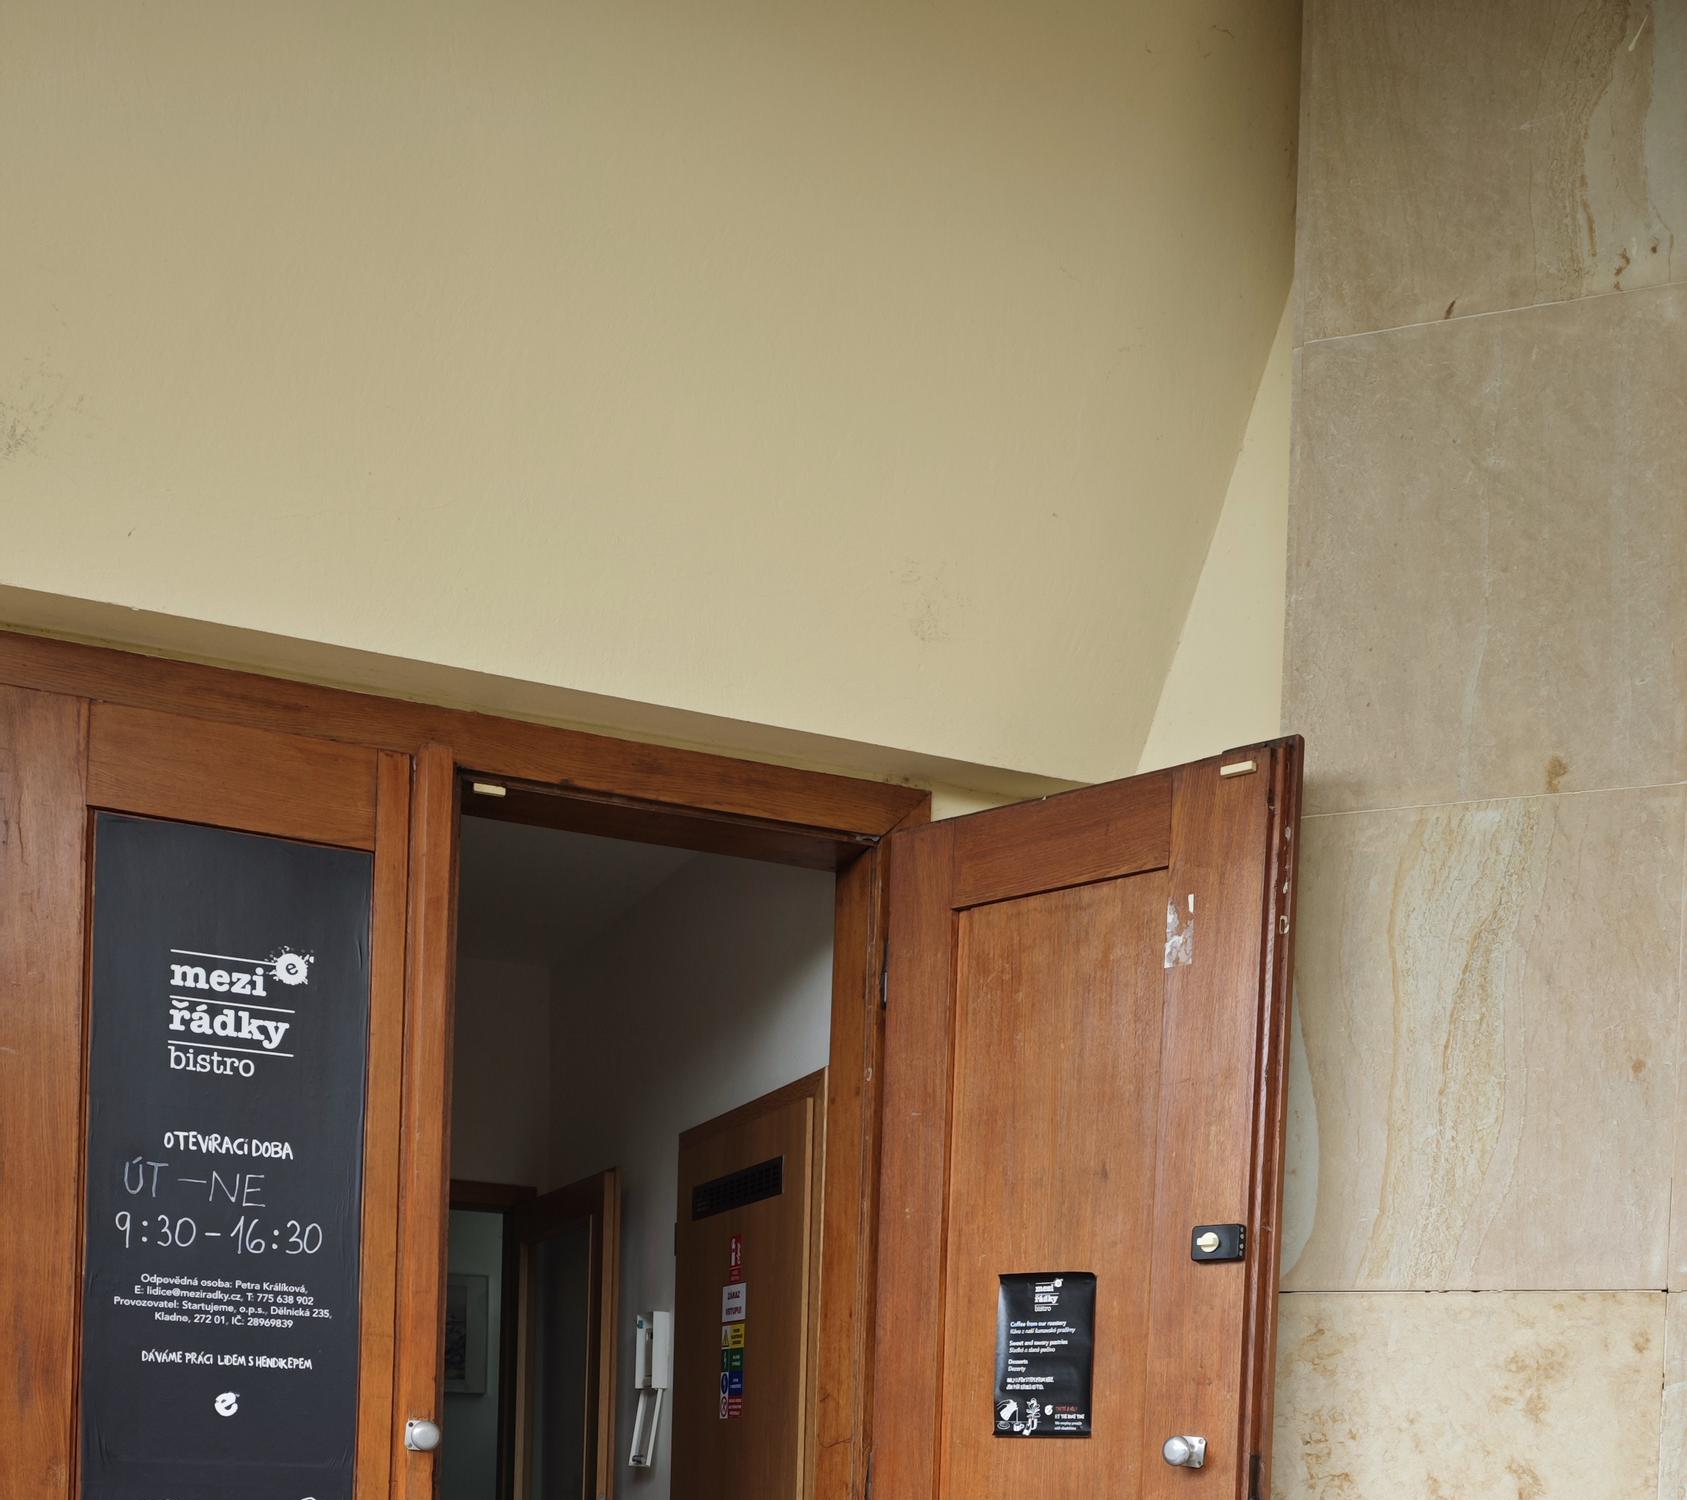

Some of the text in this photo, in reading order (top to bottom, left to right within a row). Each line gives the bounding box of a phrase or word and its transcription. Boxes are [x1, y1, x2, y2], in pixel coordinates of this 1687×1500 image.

[170, 963, 267, 996] mezi
[168, 999, 289, 1049] řádky
[168, 1046, 255, 1077] bistro
[251, 1139, 293, 1160] DOBA
[123, 1156, 168, 1197] ÚT
[208, 1170, 266, 1207] NE
[140, 1273, 308, 1294] Odpovědná osoba: Petra Králíková,
[134, 1285, 314, 1306] E: lidice@meziradky.cz, T: 775 638 902
[113, 1296, 180, 1309] Provozovatel:
[182, 1300, 237, 1313] Startujeme,
[270, 1306, 310, 1317] Dělnická
[312, 1308, 332, 1320] 235,
[154, 1312, 191, 1323] Kladno,
[193, 1314, 212, 1325] 272
[231, 1314, 245, 1326] IČ:
[247, 1317, 294, 1329] 28969839
[141, 1349, 313, 1370] DÁVÁME PRÁCI LIDEM S HENDIKEPEM
